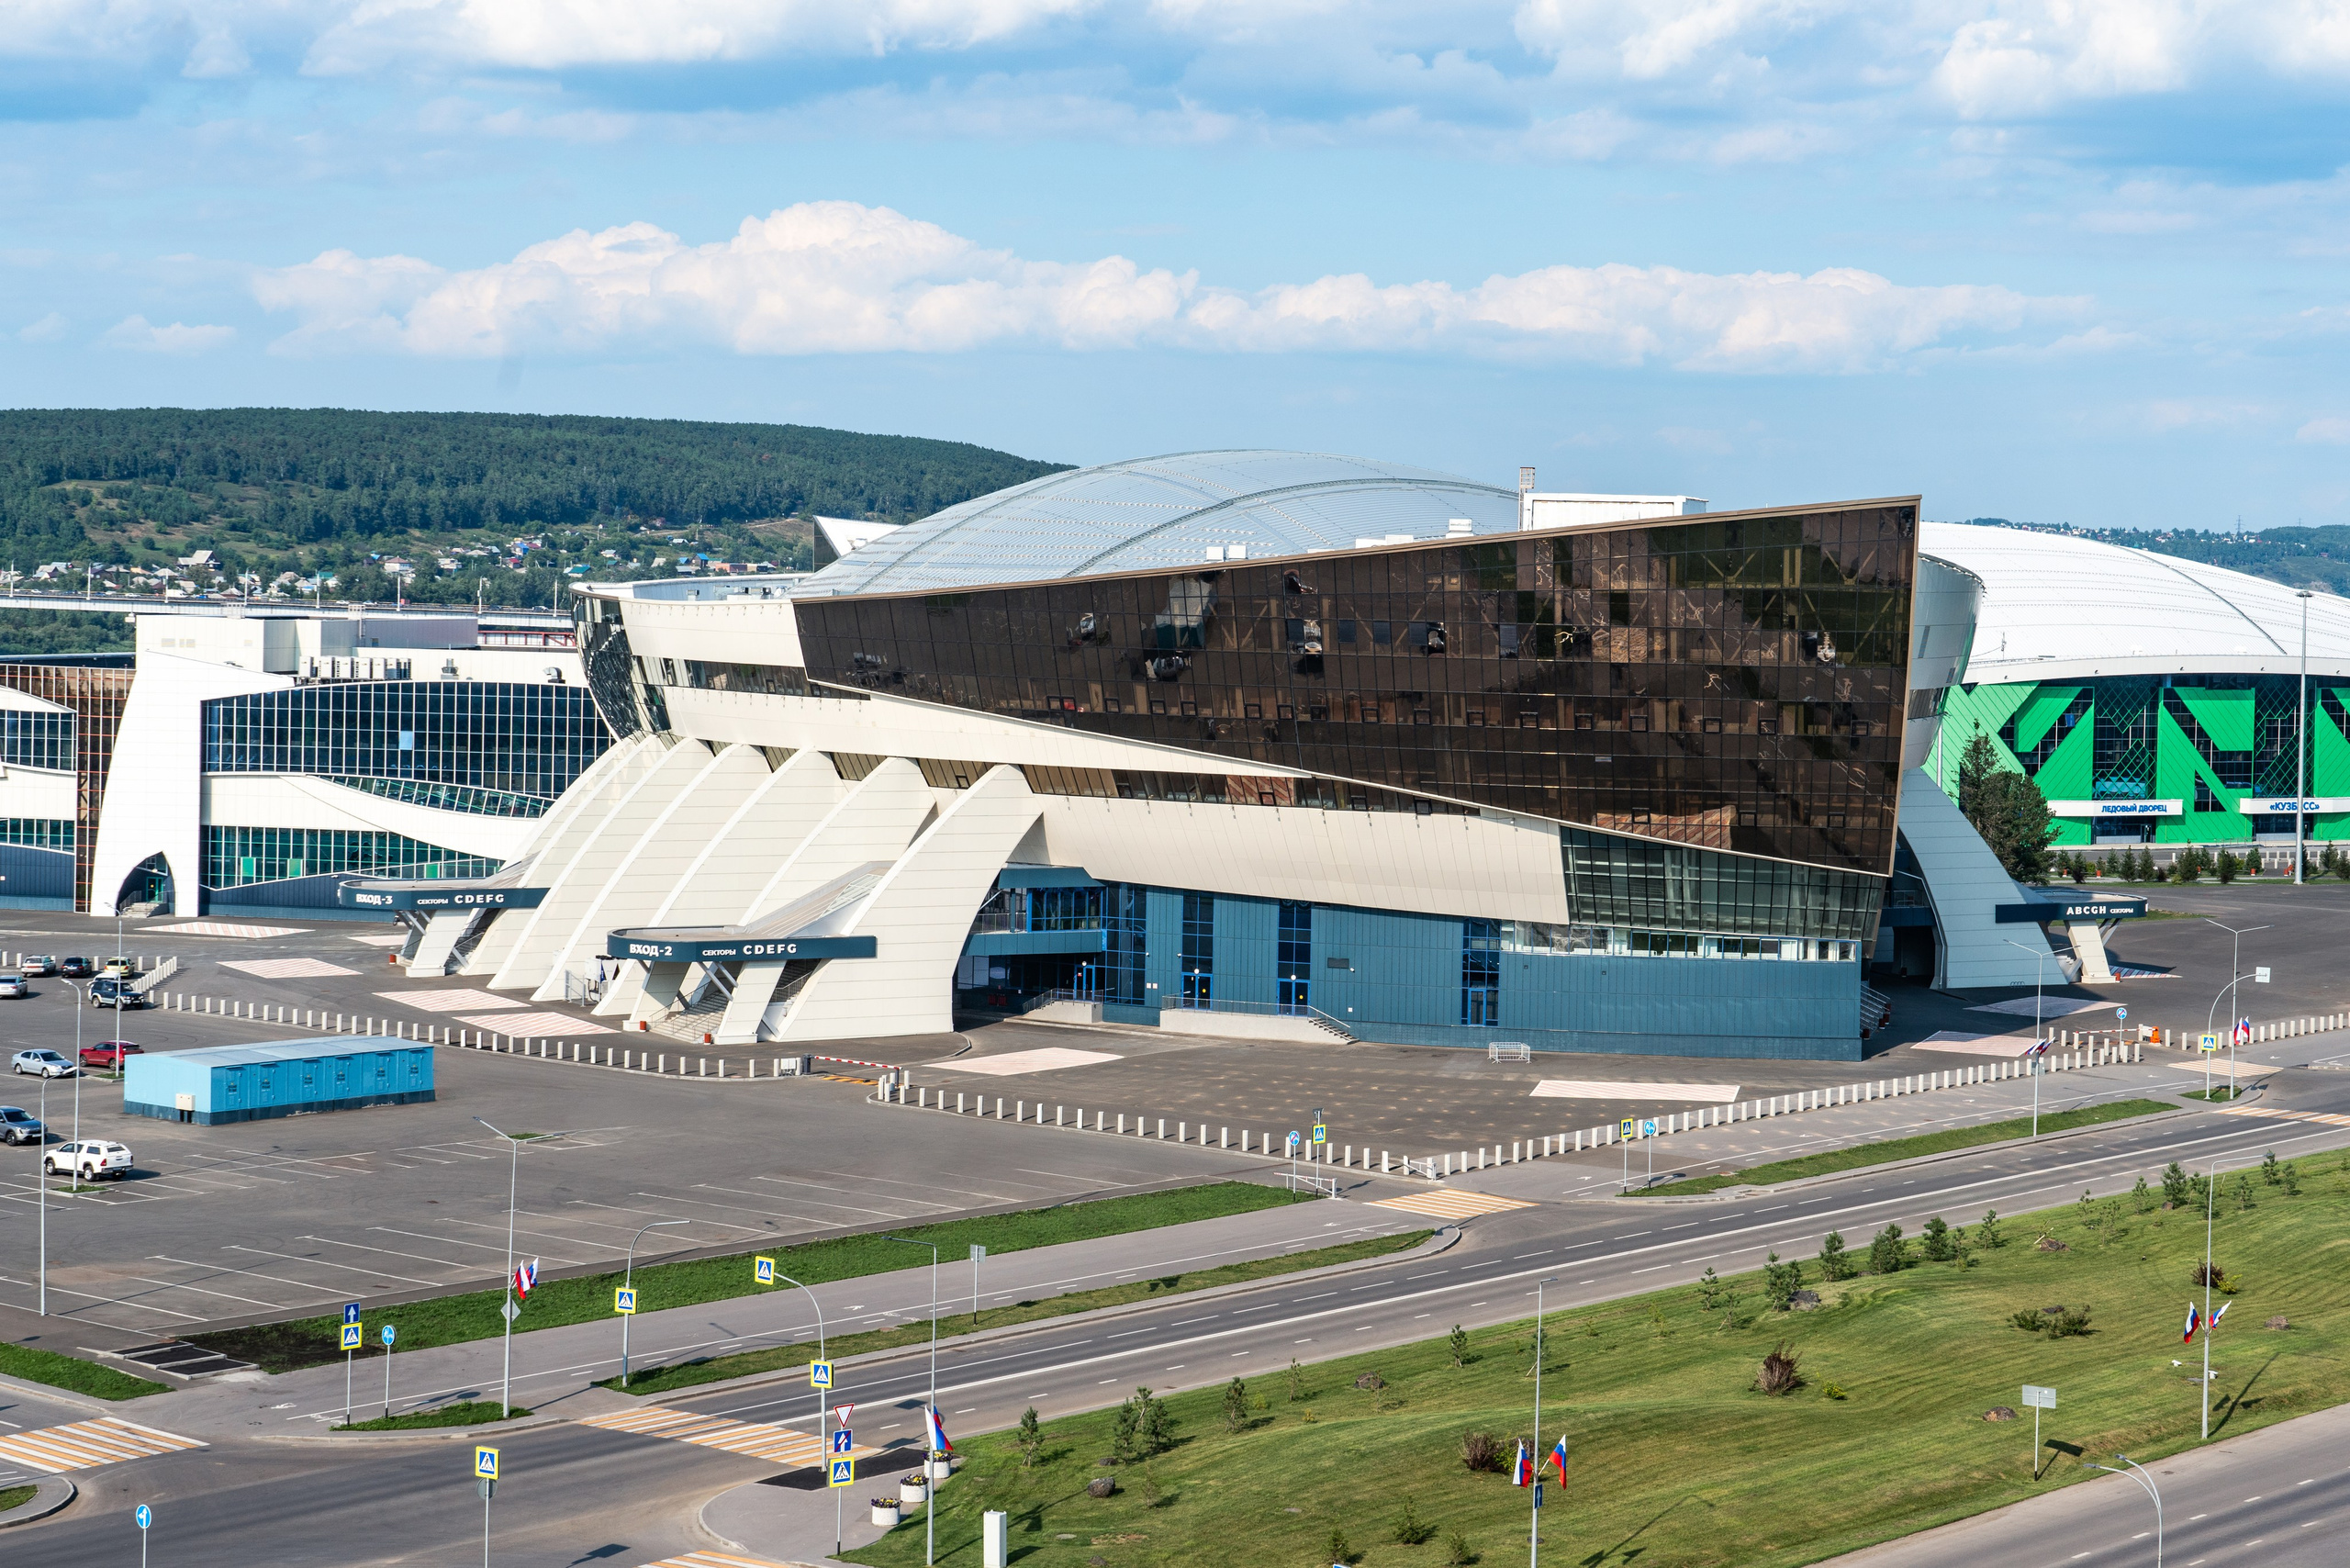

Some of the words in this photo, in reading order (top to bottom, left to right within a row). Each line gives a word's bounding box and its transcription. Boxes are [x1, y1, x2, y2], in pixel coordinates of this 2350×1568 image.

[2101, 803, 2137, 813] ЛЕДОВЫЙ
[2138, 804, 2167, 813] ДВОРЕЦ
[2269, 801, 2320, 811] «КУЗБСС»
[355, 893, 394, 906] ВХОД-3
[454, 894, 505, 904] CDEFG
[2066, 906, 2107, 915] ABCGH
[629, 943, 673, 958] ВХОД-2
[702, 948, 737, 957] СЕКТОРЫ
[743, 944, 798, 955] CDEFG
